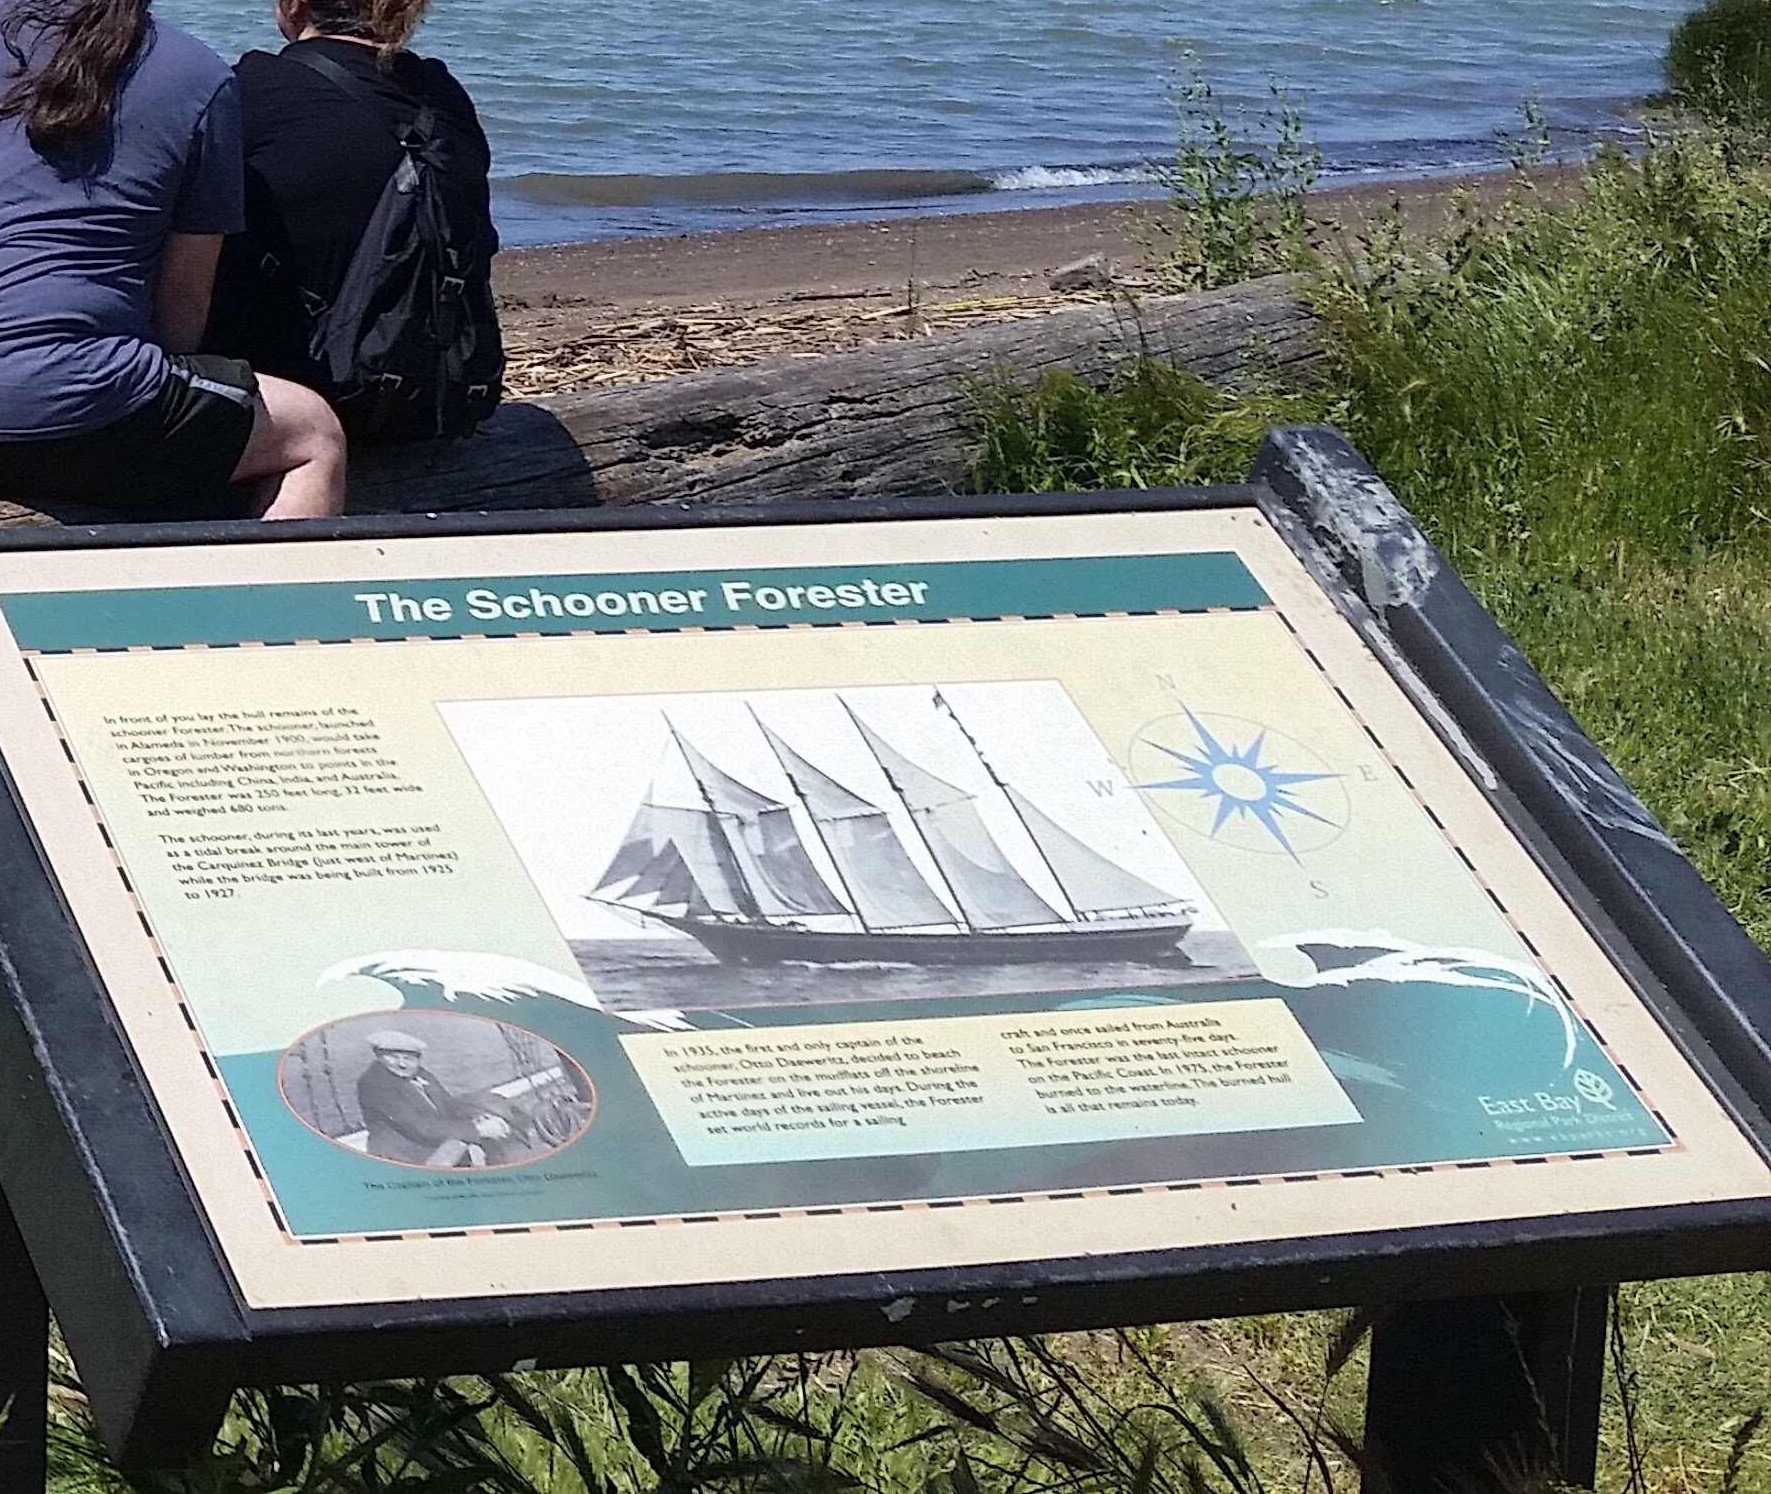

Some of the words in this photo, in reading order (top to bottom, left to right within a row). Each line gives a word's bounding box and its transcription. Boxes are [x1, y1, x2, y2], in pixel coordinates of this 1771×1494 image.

[355, 592, 452, 623] The
[466, 586, 708, 621] Schooner
[720, 578, 929, 611] Forester
[1155, 674, 1177, 690] N
[102, 715, 117, 725] In
[118, 714, 153, 724] front
[154, 713, 169, 723] of
[170, 714, 196, 724] you
[196, 712, 214, 723] lay
[217, 711, 240, 721] the
[240, 710, 266, 719] hull
[268, 709, 318, 718] remains
[320, 706, 335, 716] of
[336, 706, 359, 716] the
[109, 728, 168, 738] schooner
[226, 723, 254, 733] The
[317, 718, 375, 729] launched
[132, 779, 175, 790] Pacific
[175, 776, 236, 789] including
[315, 773, 339, 783] and
[1357, 764, 1379, 782] E
[138, 793, 167, 803] The
[168, 792, 223, 802] Forester
[253, 788, 280, 799] 250
[281, 788, 309, 797] feet
[362, 784, 390, 794] feet
[391, 783, 424, 792] wide
[1086, 779, 1115, 798] W
[146, 807, 171, 817] and
[172, 804, 227, 817] weighed
[229, 803, 254, 813] 680
[157, 833, 186, 844] The
[252, 830, 296, 841] during
[297, 830, 314, 838] its
[314, 827, 341, 837] last
[380, 826, 407, 834] was
[410, 823, 441, 833] used
[165, 850, 180, 858] as
[182, 849, 192, 857] a
[193, 845, 223, 857] tidal
[223, 844, 263, 855] break
[265, 842, 312, 854] around
[314, 842, 337, 851] the
[339, 842, 372, 850] main
[373, 840, 412, 849] tower
[417, 836, 431, 847] of
[171, 862, 194, 872] the
[196, 860, 265, 872] Carquinez
[265, 857, 310, 869] Bridge
[311, 856, 342, 868] (just
[343, 855, 377, 864] west
[378, 852, 393, 863] of
[394, 850, 459, 862] Martinez)
[177, 875, 214, 885] while
[215, 874, 239, 884] the
[240, 872, 284, 884] bridge
[285, 872, 313, 880] was
[313, 870, 353, 881] being
[351, 867, 384, 878] built
[384, 866, 419, 876] from
[421, 863, 454, 874] 1925
[1309, 880, 1329, 899] S
[999, 1027, 1032, 1040] craft
[1032, 1026, 1058, 1038] and
[1059, 1026, 1092, 1036] once
[1094, 1022, 1131, 1034] sailed
[1130, 1021, 1165, 1032] from
[1165, 1017, 1222, 1029] Australia
[662, 1047, 679, 1057] In
[718, 1045, 743, 1055] the
[744, 1043, 775, 1054] first
[775, 1041, 801, 1052] and
[803, 1039, 831, 1052] only
[834, 1038, 882, 1051] captain
[883, 1035, 899, 1047] of
[900, 1035, 924, 1045] the
[1008, 1046, 1025, 1054] to
[1025, 1042, 1051, 1053] San
[1050, 1040, 1114, 1052] Francisco
[1114, 1038, 1130, 1047] in
[1131, 1033, 1206, 1047] seventy-five
[1015, 1058, 1045, 1069] The
[1044, 1056, 1100, 1067] Forester
[1103, 1054, 1131, 1063] was
[1131, 1051, 1155, 1062] the
[1154, 1050, 1182, 1060] last
[1180, 1048, 1220, 1059] intact
[1220, 1045, 1278, 1056] schooner
[1027, 1075, 1046, 1084] on
[1046, 1072, 1071, 1083] the
[1070, 1068, 1115, 1081] Pacific
[1157, 1065, 1173, 1075] In
[1210, 1062, 1234, 1073] the
[1233, 1059, 1289, 1071] Forester
[689, 1092, 705, 1104] of
[705, 1091, 768, 1103] Martinez
[769, 1087, 795, 1099] and
[795, 1087, 821, 1098] live
[823, 1087, 849, 1097] out
[848, 1084, 870, 1095] his
[904, 1080, 955, 1093] During
[953, 1078, 978, 1089] the
[1033, 1085, 1084, 1099] burned
[1084, 1087, 1102, 1096] to
[1103, 1083, 1128, 1095] the
[1189, 1077, 1218, 1089] The
[1216, 1074, 1267, 1087] burned
[1265, 1072, 1292, 1084] hull
[1059, 1102, 1076, 1113] all
[1076, 1101, 1107, 1112] that
[1106, 1098, 1159, 1110] remains
[1478, 1096, 1535, 1115] East
[1534, 1092, 1581, 1114] Bay
[706, 1125, 729, 1135] set
[729, 1121, 772, 1133] world
[773, 1118, 827, 1131] records
[827, 1117, 849, 1128] for
[852, 1118, 863, 1127] a
[863, 1114, 908, 1127] sailing
